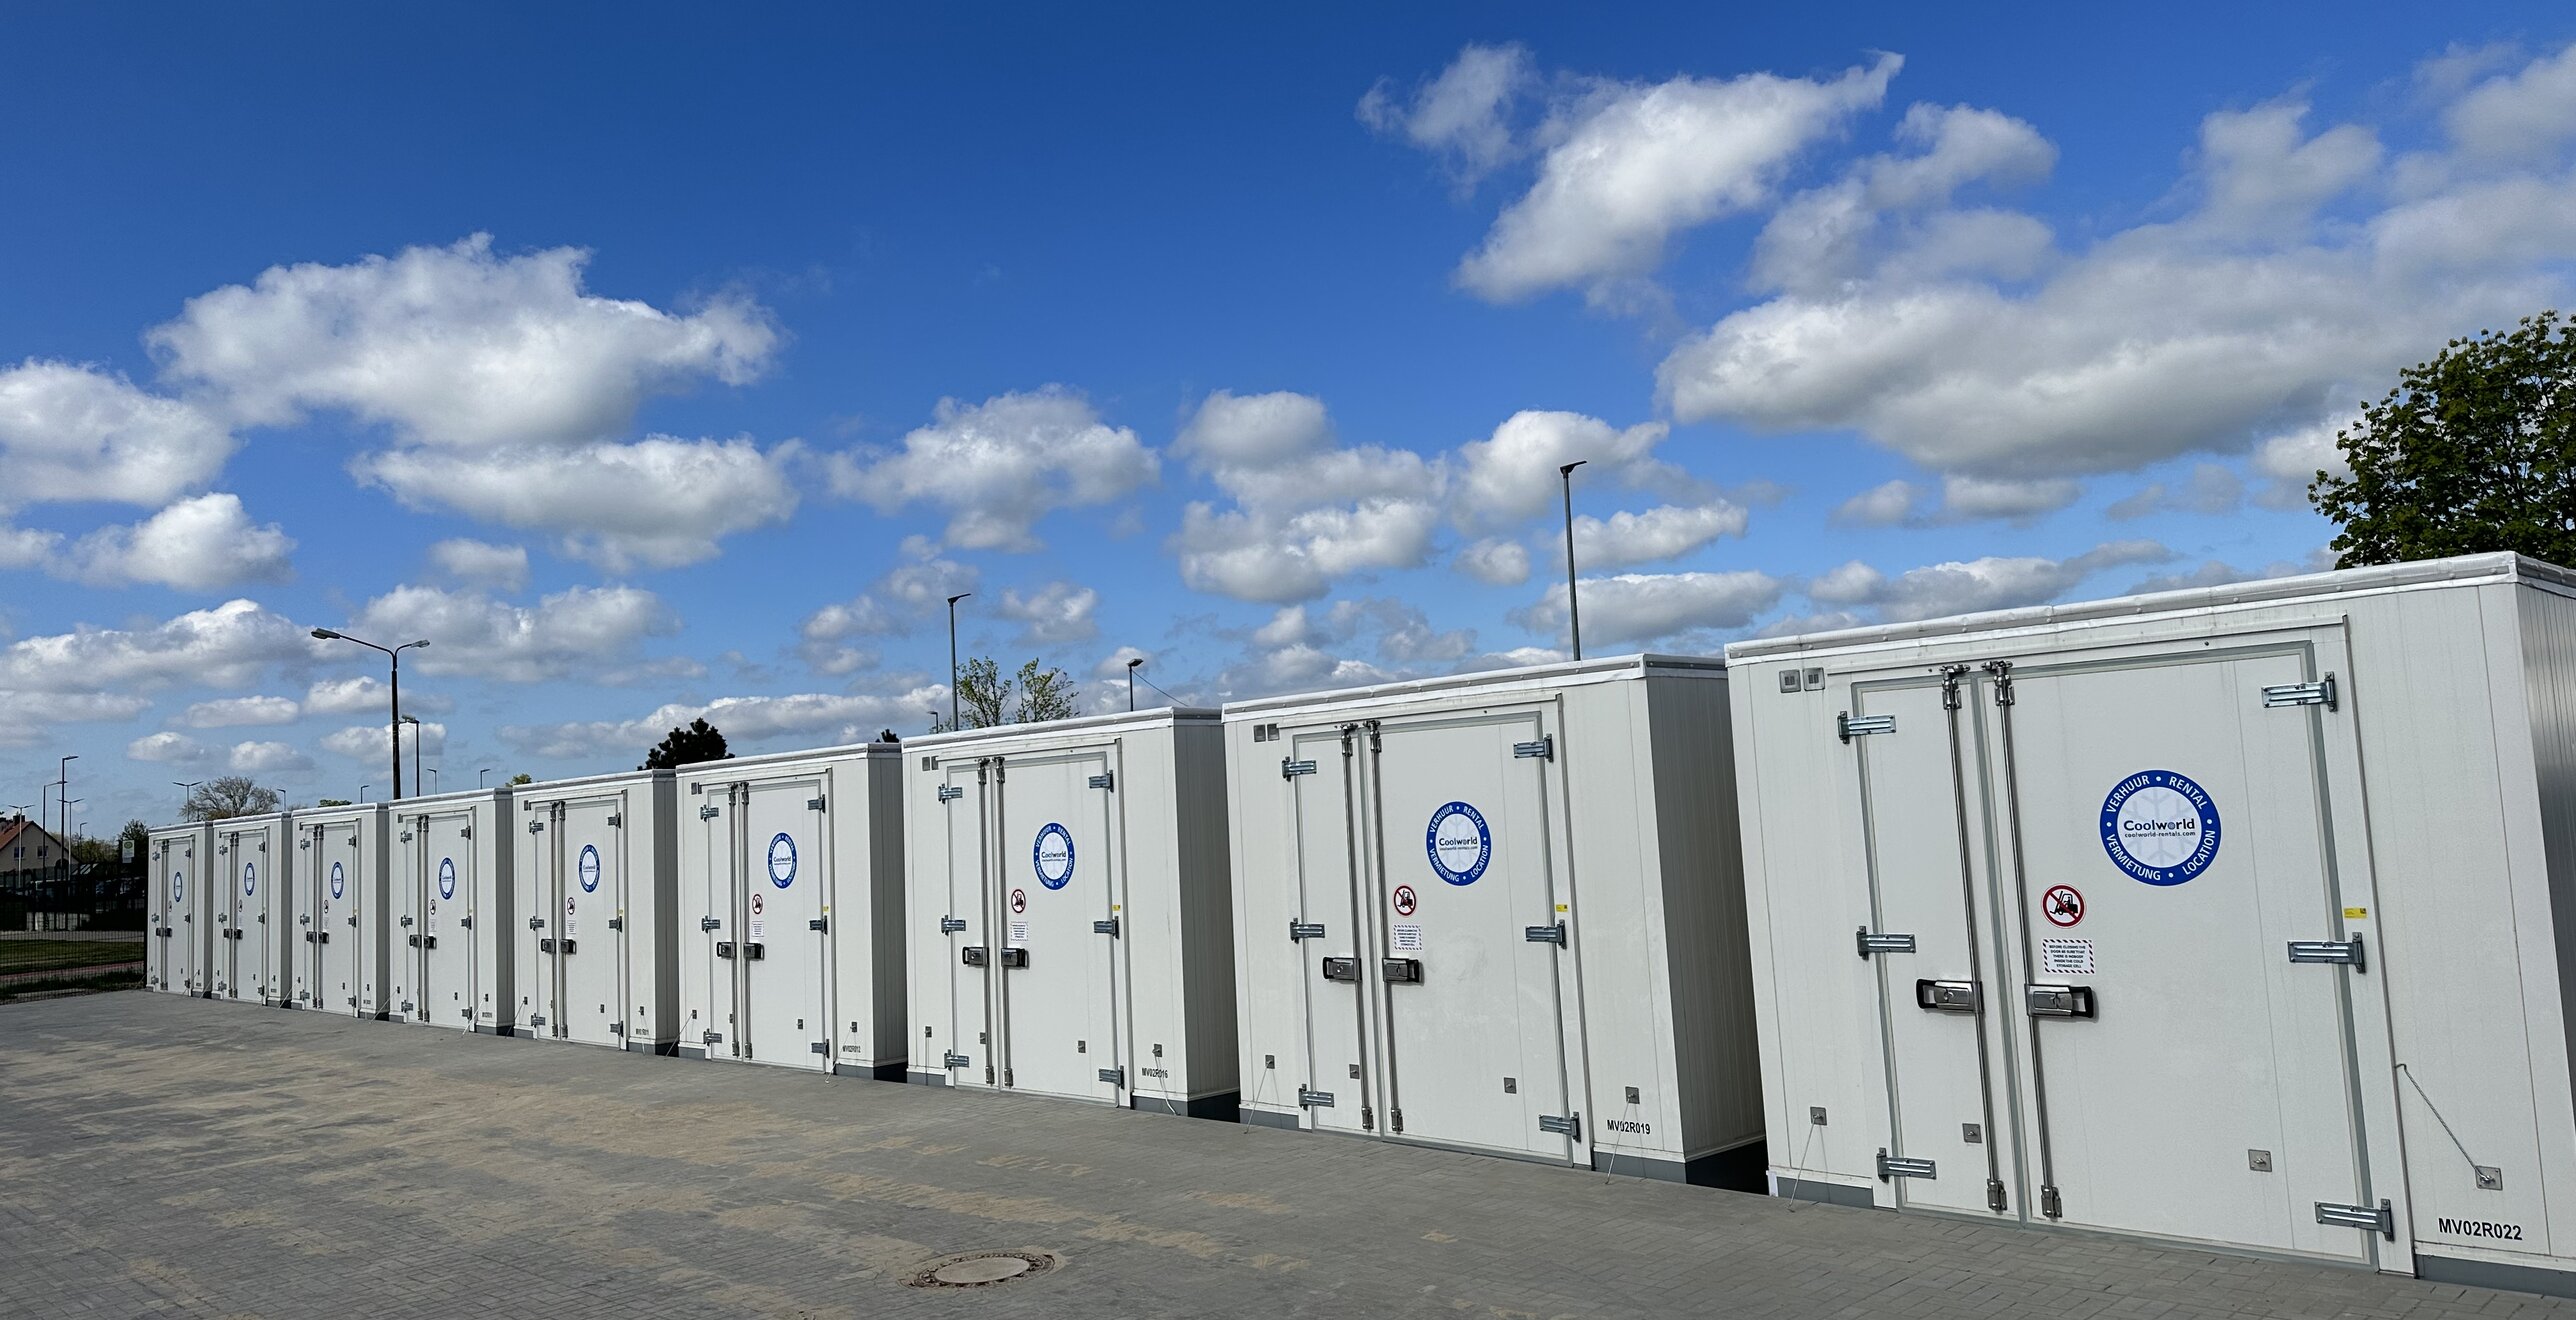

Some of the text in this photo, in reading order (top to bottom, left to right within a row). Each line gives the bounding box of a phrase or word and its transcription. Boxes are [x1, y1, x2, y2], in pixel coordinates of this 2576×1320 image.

[2106, 775, 2208, 813] VERHUUR RENTAL
[1429, 805, 1485, 833] VERHUUR RENTAL
[2123, 818, 2196, 831] Coolworld
[1439, 836, 1478, 846] Coolworld
[1429, 845, 1489, 882] VERMIETUNG LOCATION
[2106, 830, 2216, 881] VERMIETUNG LOCATION
[1606, 1119, 1651, 1135] MV02R019
[2438, 1217, 2523, 1240] MV02R022
